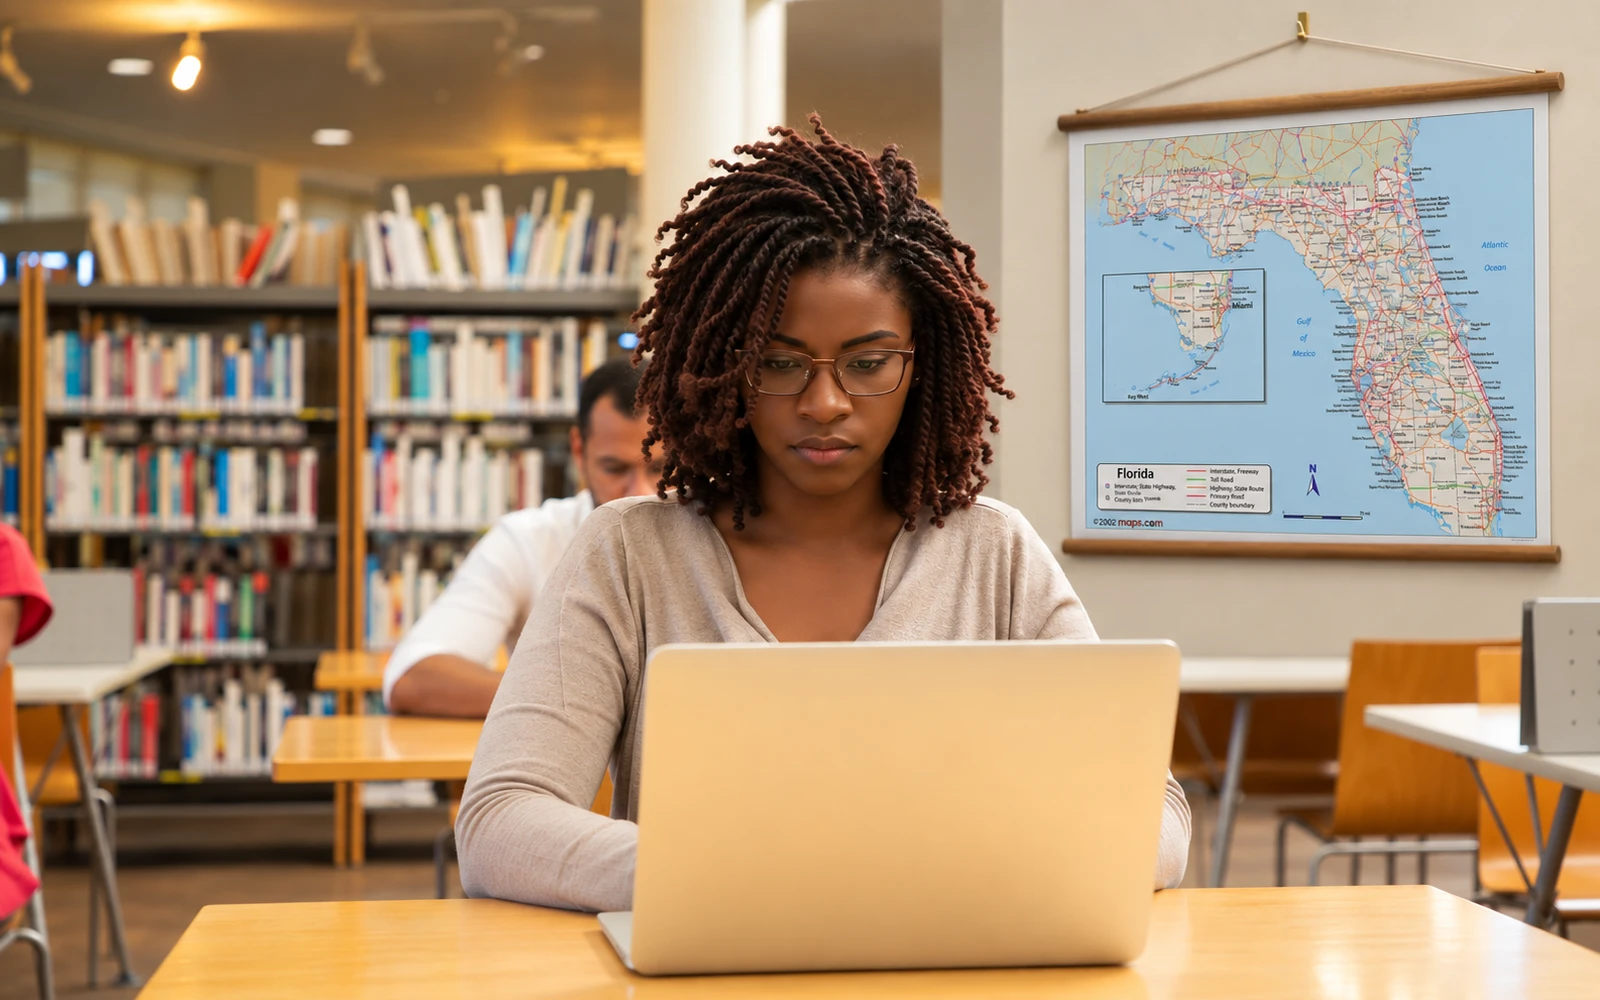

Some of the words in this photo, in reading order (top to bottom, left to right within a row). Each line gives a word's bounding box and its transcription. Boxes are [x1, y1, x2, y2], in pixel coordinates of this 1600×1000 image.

[1481, 240, 1509, 249] Atlantic
[1484, 263, 1507, 272] Ocean
[1232, 301, 1253, 309] Miami
[1296, 316, 1312, 326] Gulf
[1300, 333, 1308, 342] of
[1309, 463, 1317, 473] N
[1117, 467, 1154, 479] Florida
[1118, 519, 1163, 529] maps.com
